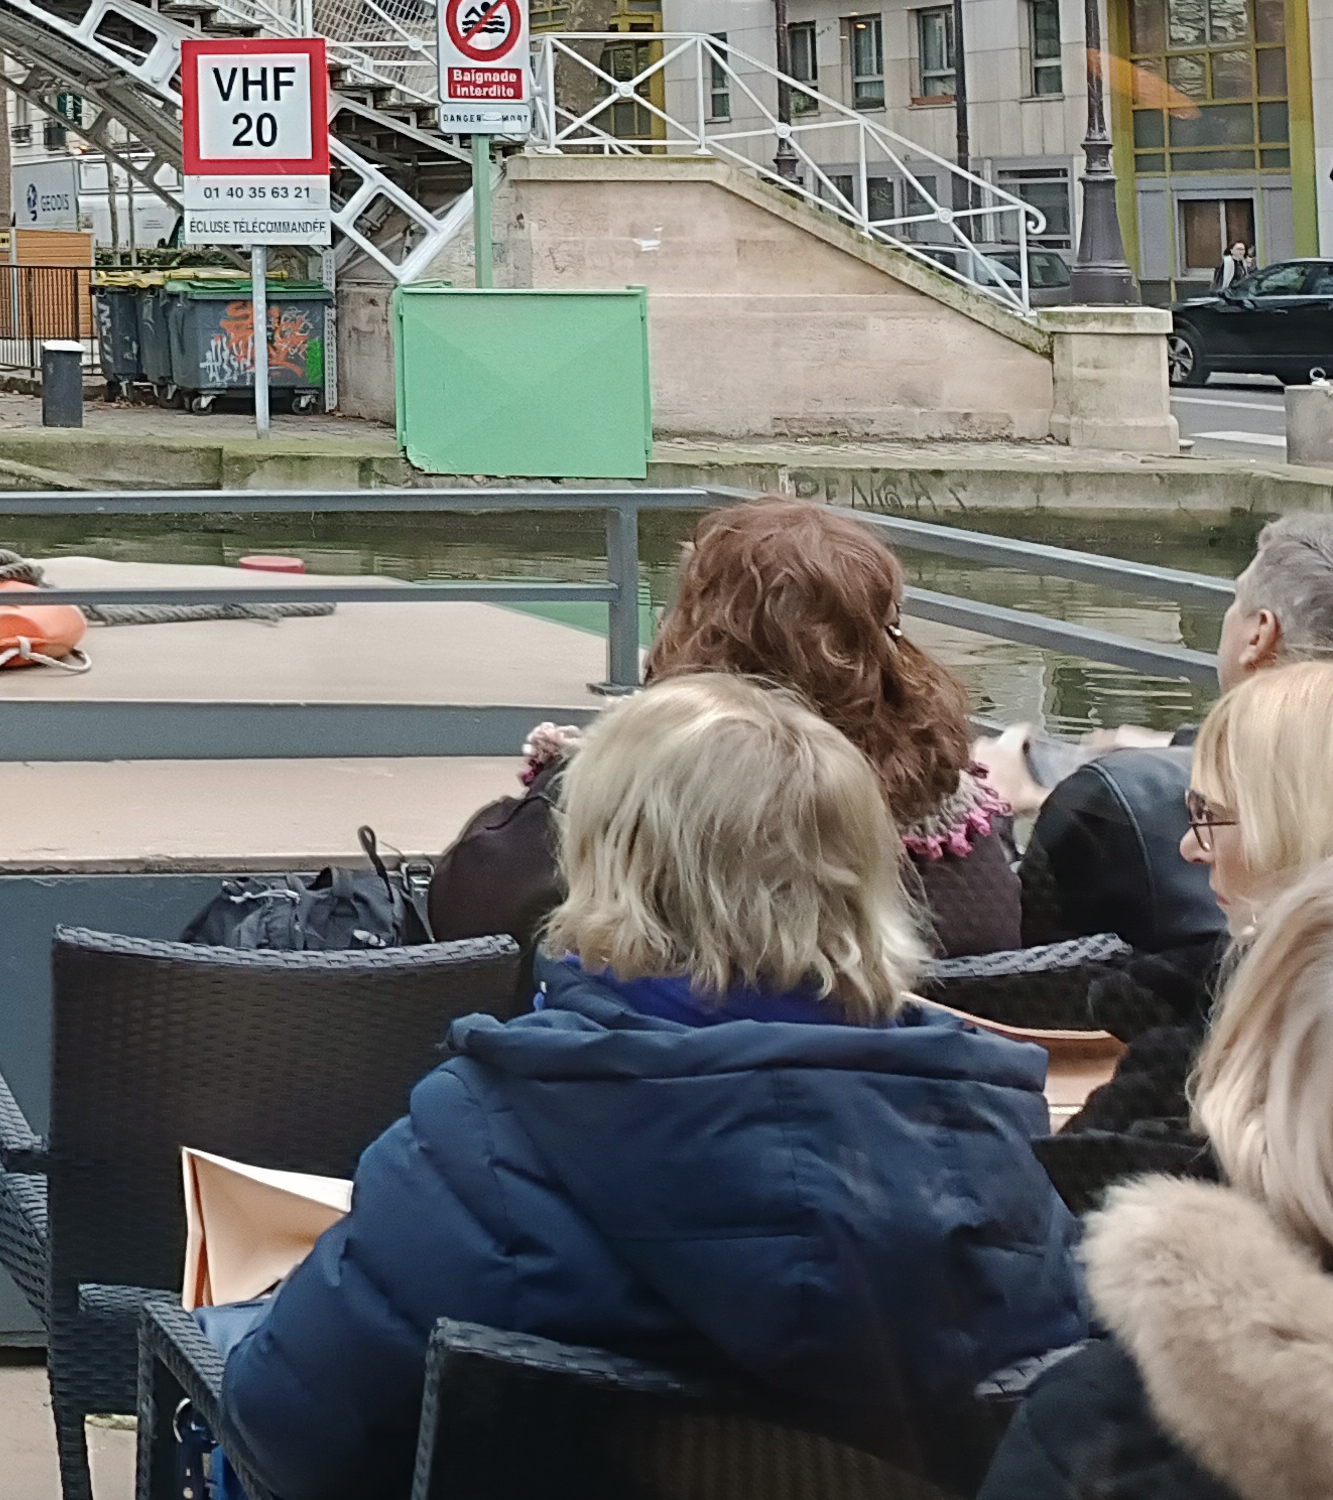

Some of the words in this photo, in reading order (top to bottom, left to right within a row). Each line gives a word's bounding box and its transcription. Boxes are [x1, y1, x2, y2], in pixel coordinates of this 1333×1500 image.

[212, 66, 296, 101] VHF
[453, 69, 517, 84] Baignade
[455, 84, 515, 97] interdite
[443, 113, 482, 123] DANGER
[232, 112, 278, 148] 20
[203, 186, 220, 199] 01
[226, 186, 244, 199] 40
[248, 186, 266, 199] 35
[271, 186, 289, 199] 63
[294, 186, 311, 199] 21
[41, 193, 70, 212] GEODIS
[190, 217, 231, 234] ÉCLUSE
[232, 217, 326, 234] TÉLÉCOMMANDÉE
